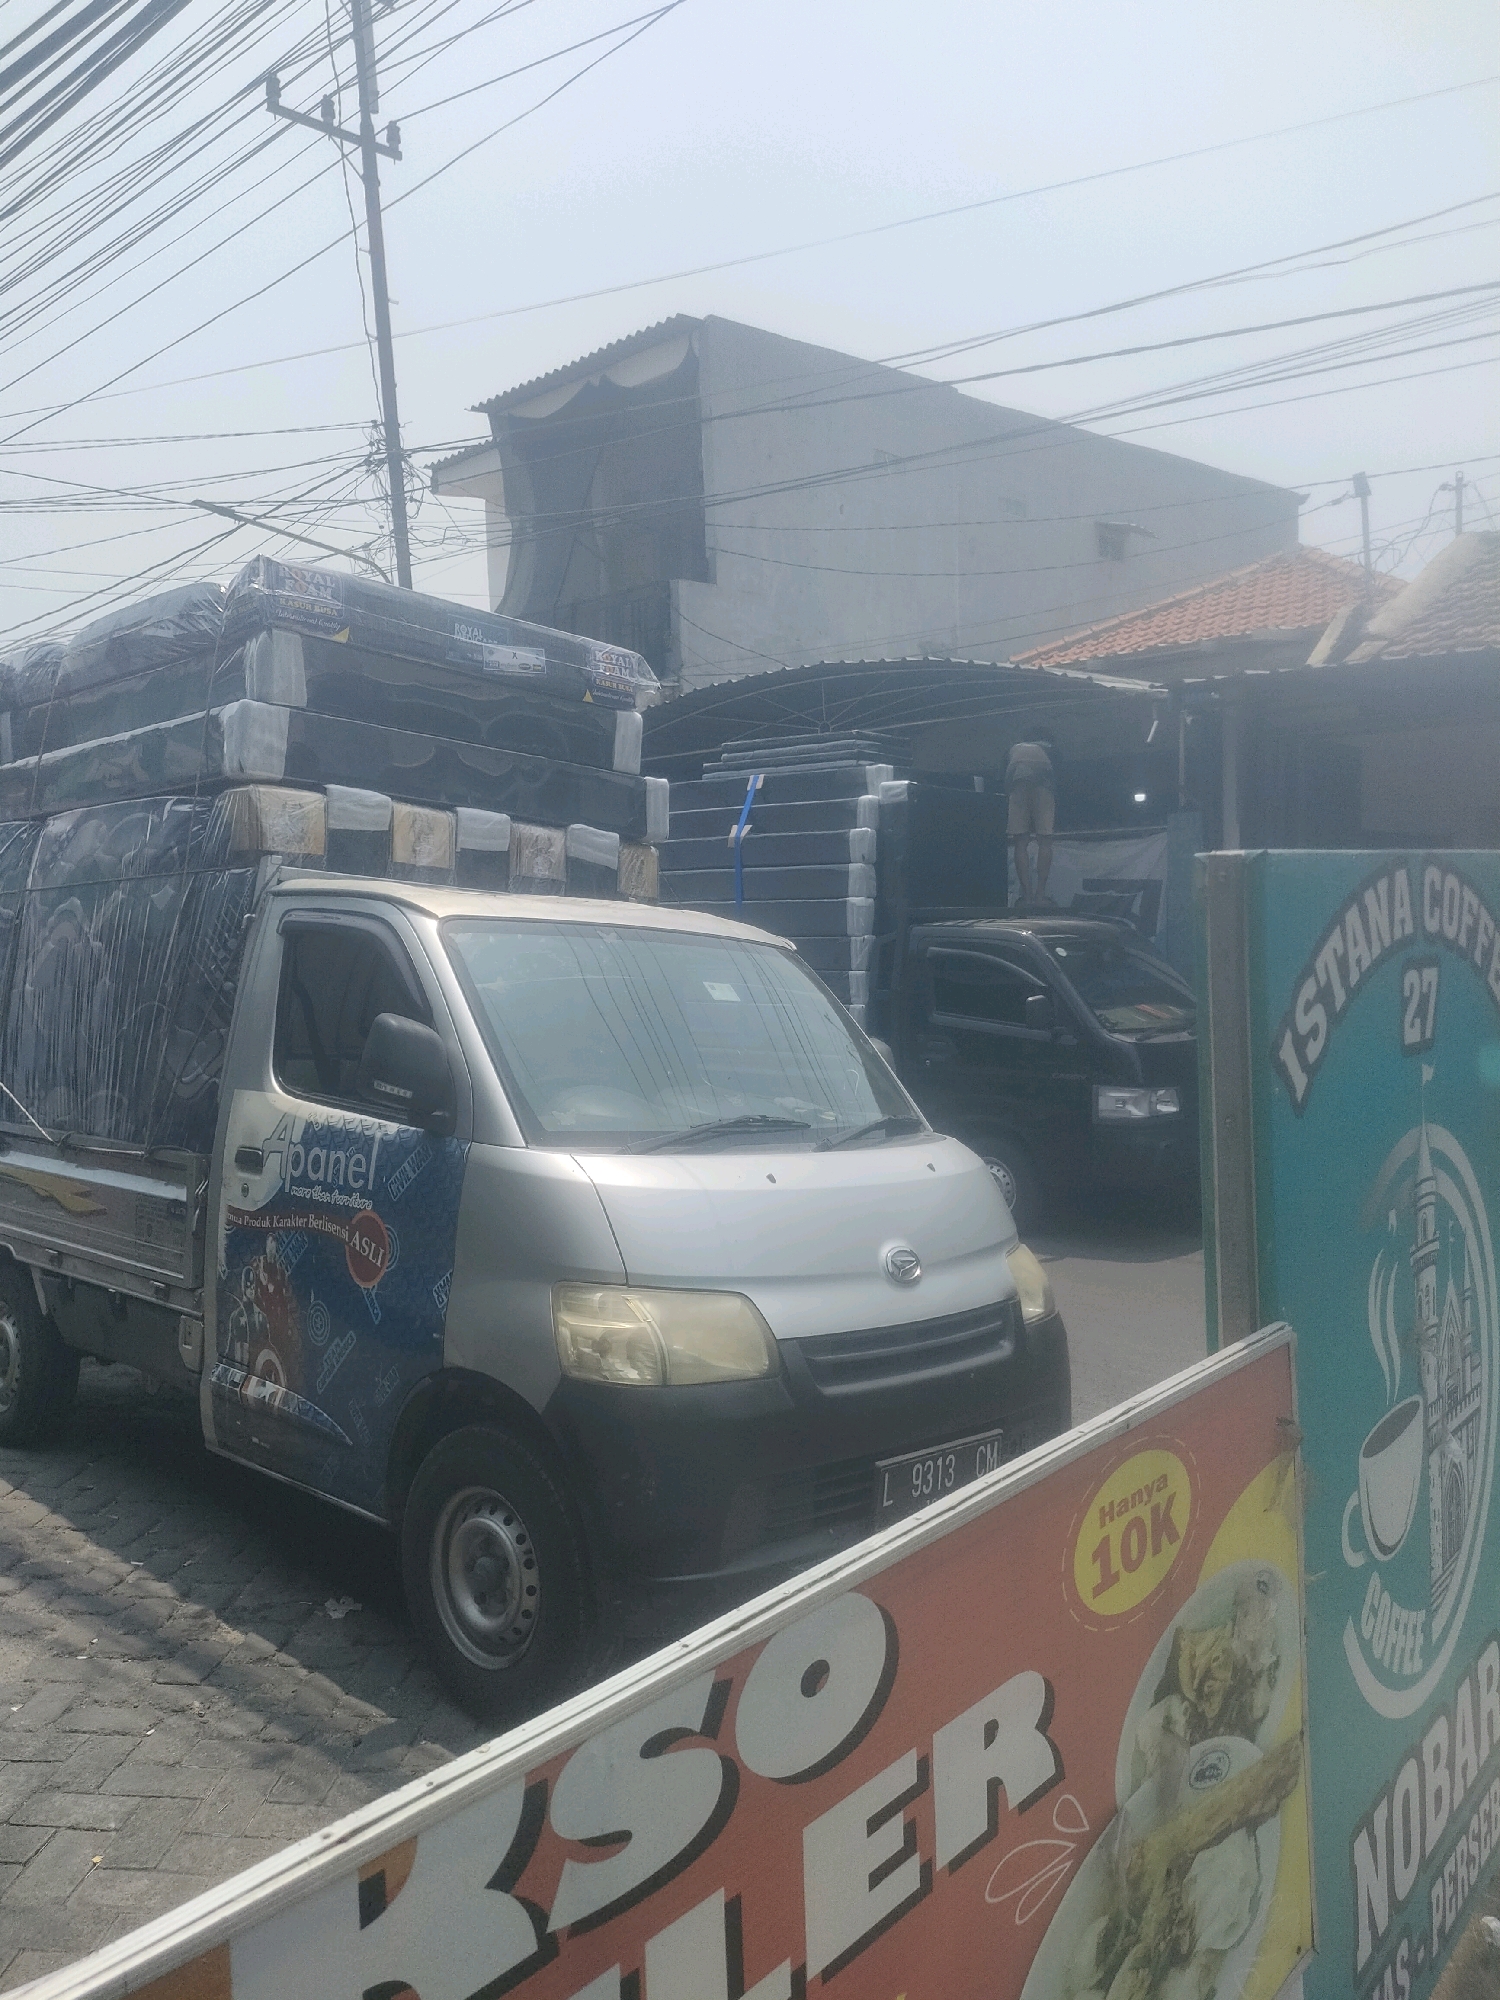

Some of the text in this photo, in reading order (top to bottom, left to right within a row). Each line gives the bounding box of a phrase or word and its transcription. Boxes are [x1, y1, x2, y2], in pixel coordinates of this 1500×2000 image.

[280, 565, 336, 588] ROYAL
[285, 578, 333, 600] FOAM
[280, 598, 338, 617] KASUR BUSA
[454, 622, 483, 640] ROYAL
[594, 650, 632, 668] ROYAL
[1278, 868, 1414, 1103] ISTANA
[1403, 966, 1439, 1046] 27
[290, 1186, 312, 1199] more
[331, 1188, 373, 1211] furniture
[243, 1215, 272, 1229] Produk
[272, 1213, 310, 1229] Karakter
[308, 1213, 350, 1242] Berlisensi
[350, 1230, 385, 1268] ASLI
[883, 1441, 999, 1508] L 9313 CM
[1100, 1473, 1169, 1528] Hanya
[1090, 1491, 1181, 1600] 10K
[1360, 1571, 1427, 1676] COFFEE
[1353, 1640, 1500, 1976] NOBAR
